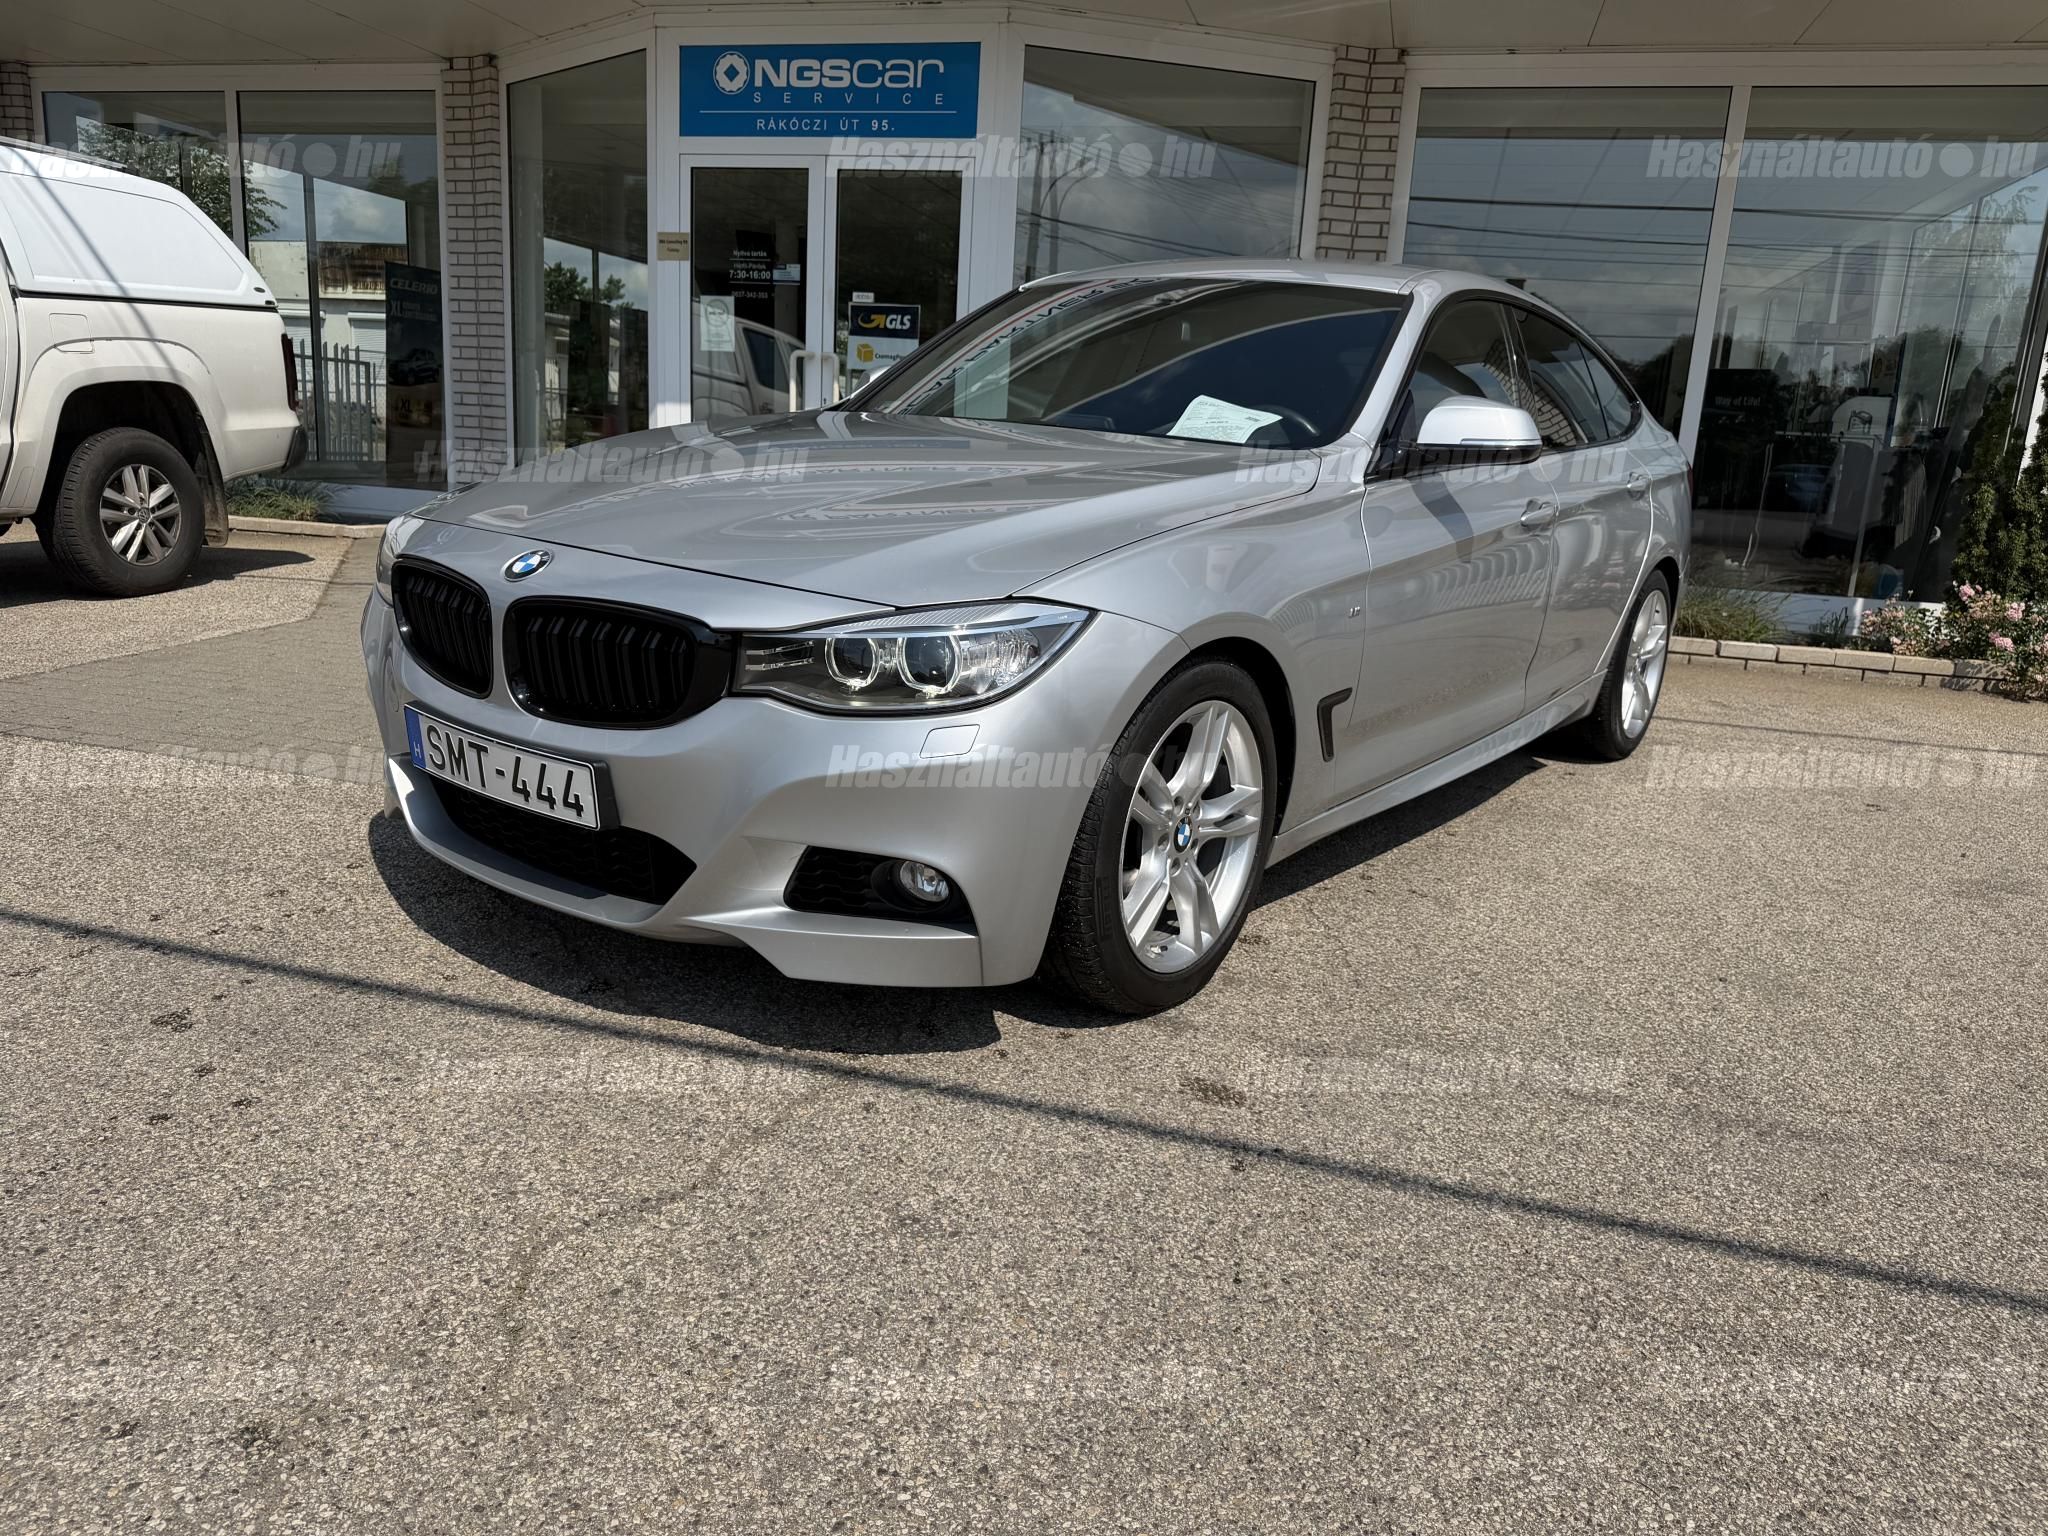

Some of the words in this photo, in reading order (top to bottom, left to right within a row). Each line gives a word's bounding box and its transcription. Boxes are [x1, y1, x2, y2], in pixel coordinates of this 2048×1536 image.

[756, 117, 828, 131] RÁKÓCZI
[839, 117, 860, 131] ÚT
[871, 119, 896, 131] 95.
[729, 270, 771, 280] 7:30-16:00
[390, 277, 439, 295] CELERIO
[885, 314, 912, 331] GLS
[426, 723, 585, 819] SMT-444
